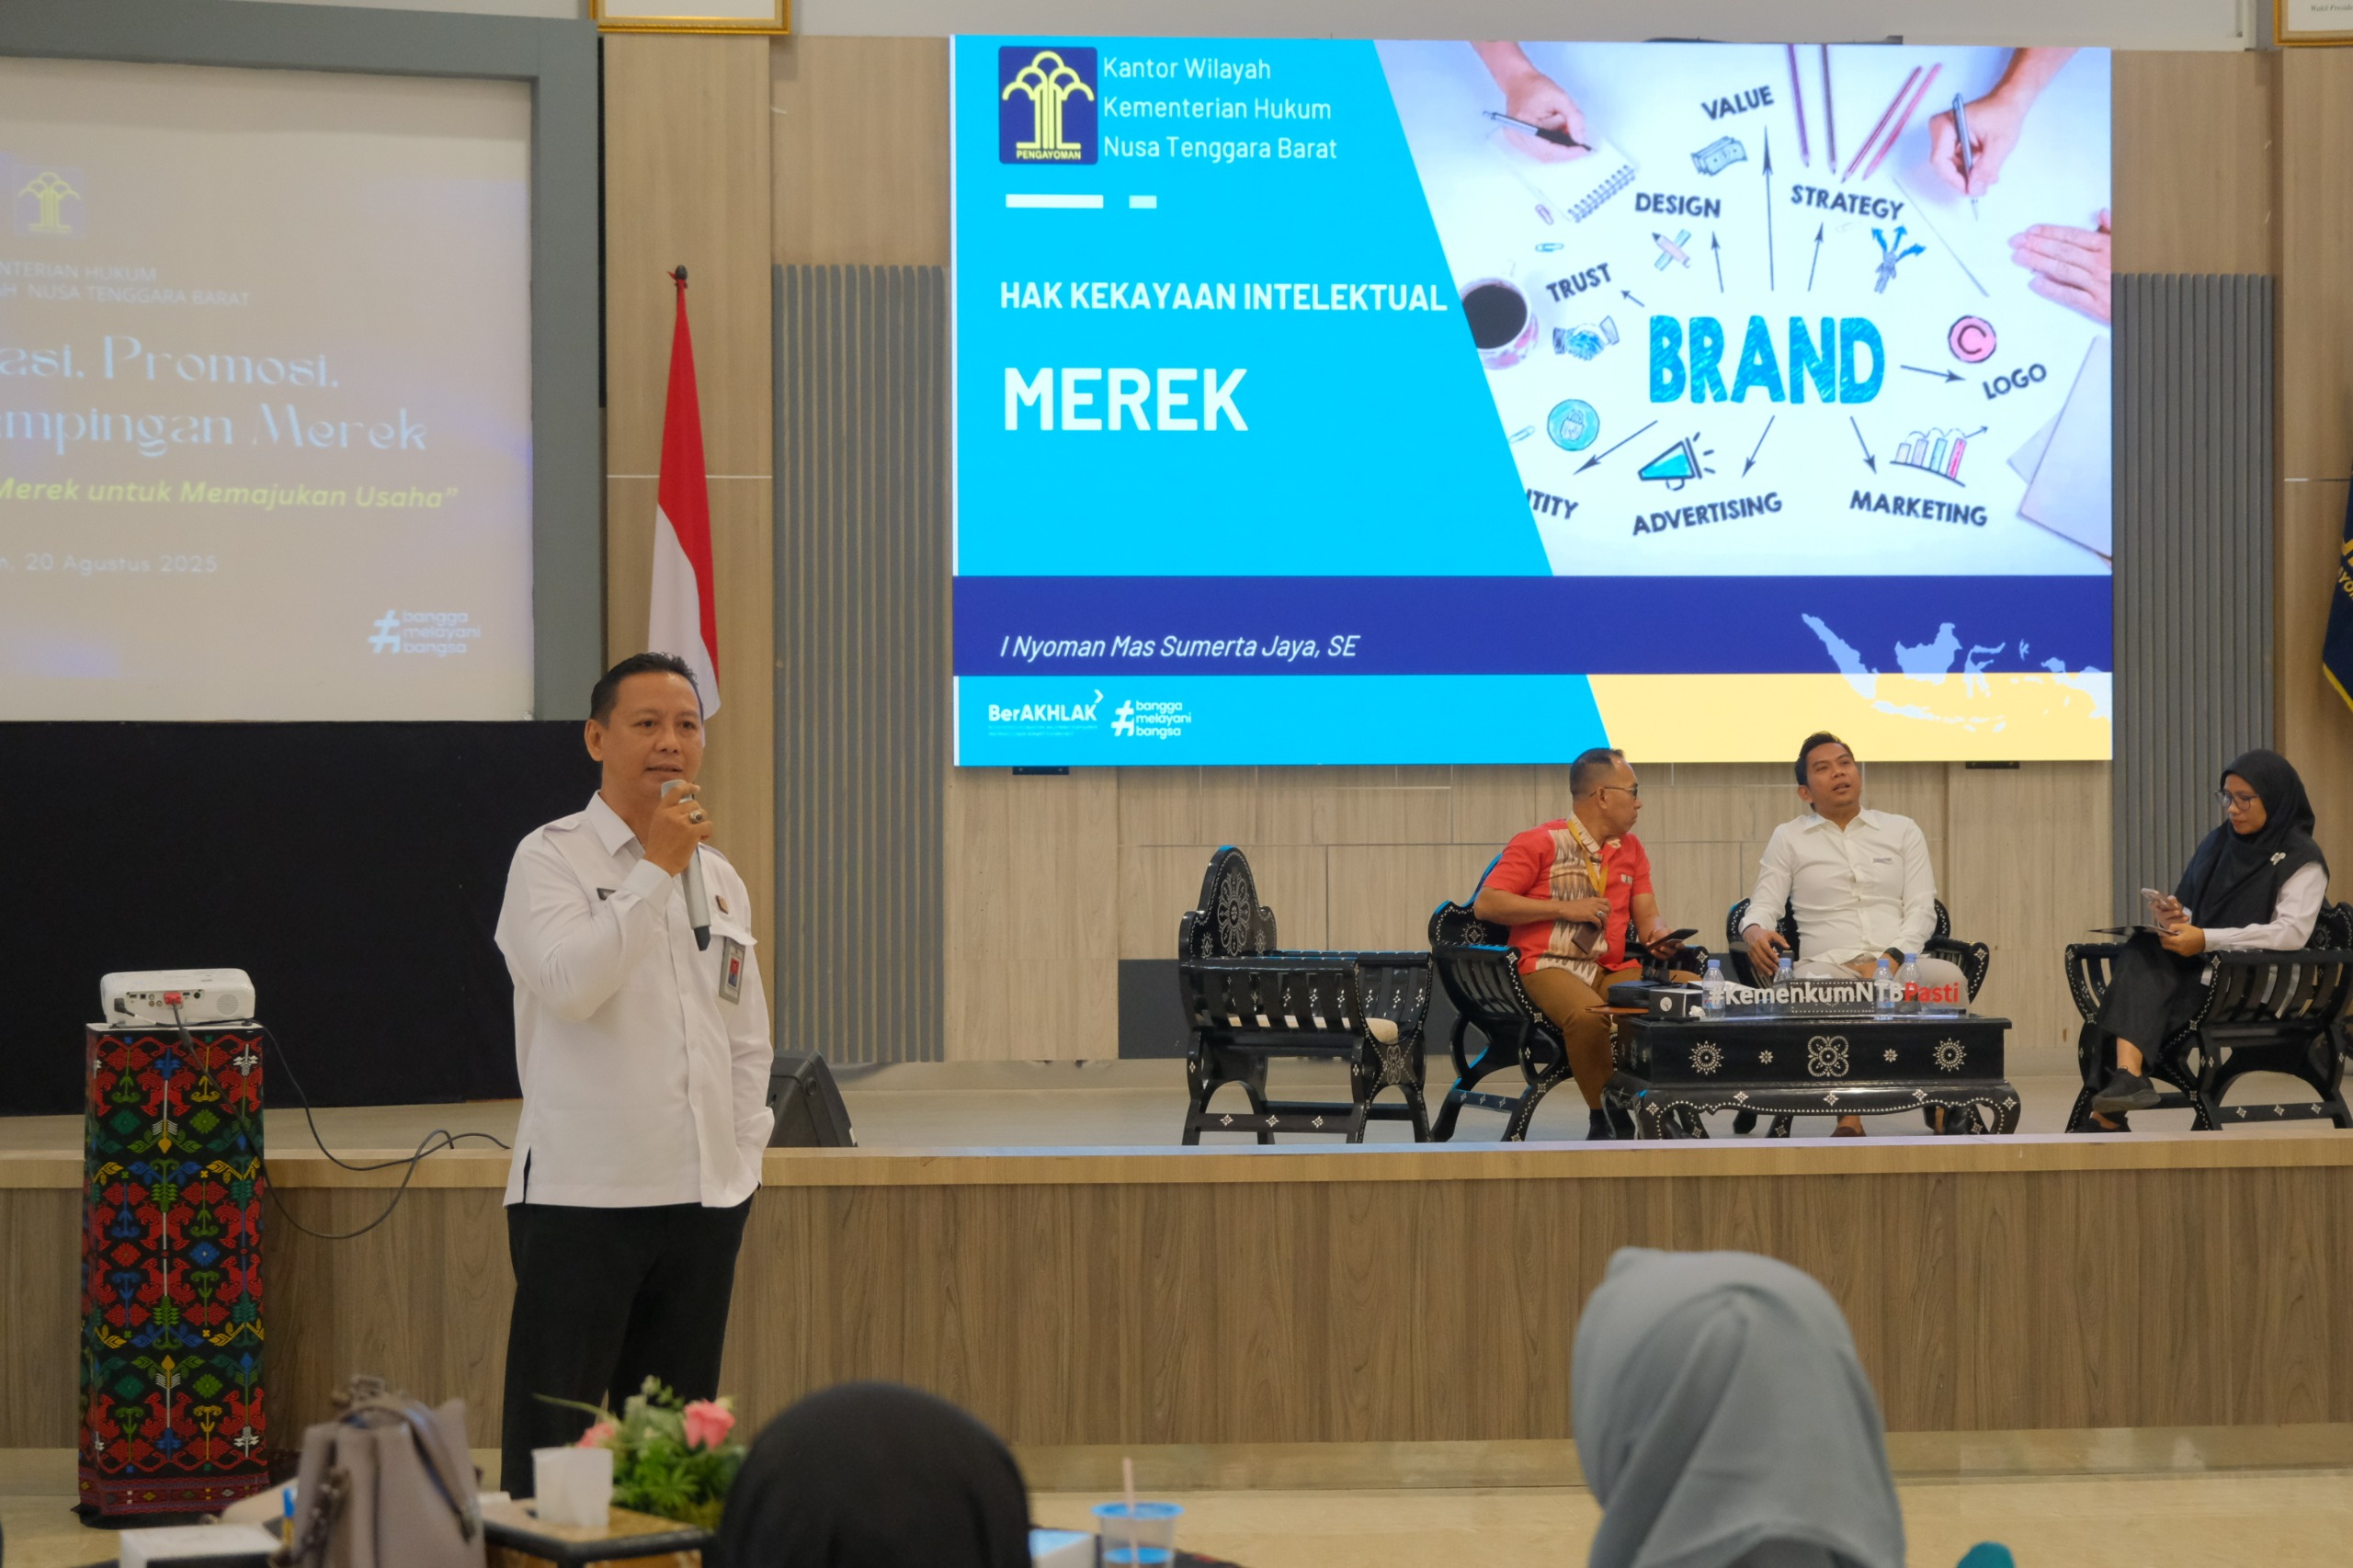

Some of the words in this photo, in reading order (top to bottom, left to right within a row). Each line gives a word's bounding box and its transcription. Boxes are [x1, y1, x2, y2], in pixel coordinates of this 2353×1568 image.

[1104, 57, 1178, 79] Kantor
[1185, 58, 1271, 85] Wilayah
[1104, 97, 1247, 119] Kementerian
[1255, 98, 1331, 119] Hukum
[1701, 85, 1775, 121] VALUE
[1016, 149, 1082, 160] PENGAYOMAN
[1104, 136, 1160, 158] Nusa
[1166, 136, 1271, 164] Tenggara
[1278, 138, 1337, 159] Barat
[1634, 193, 1722, 218] DESIGN
[1791, 185, 1904, 221] STRATEGY
[85, 266, 157, 282] HUKUM
[1546, 263, 1611, 303] TRUST
[28, 284, 81, 300] NUSA
[86, 285, 188, 304] TENGGARA
[191, 289, 251, 306] BARAT
[1000, 282, 1063, 309] HAK
[1070, 282, 1235, 310] KEKAYAAN
[1245, 283, 1449, 311] INTELEKTUAL
[1649, 315, 1885, 404] BRAND
[1983, 364, 2048, 401] LOGO
[1004, 368, 1248, 432] MEREK
[0, 407, 233, 458] mpingan
[252, 403, 426, 450] Merek
[87, 480, 173, 502] untuk
[179, 481, 347, 511] Memajukan
[1849, 490, 1988, 528] MARKETING
[1633, 493, 1782, 536] ADVERTISING
[26, 552, 54, 571] 20
[63, 554, 151, 576] Agustus
[160, 554, 218, 573] 2025
[403, 611, 469, 626] bangga
[404, 626, 482, 642] melayani
[404, 642, 467, 657] bangsa
[1013, 636, 1105, 663] Nyoman
[1110, 636, 1156, 657] Mas
[1160, 636, 1257, 658] Sumerta
[1261, 636, 1320, 662] Jaya,
[1328, 635, 1361, 657] SE
[988, 704, 1098, 722] BerAKHLAK
[1136, 700, 1183, 714] bangga
[1136, 712, 1192, 726] melayani
[1136, 726, 1181, 739] bangsa
